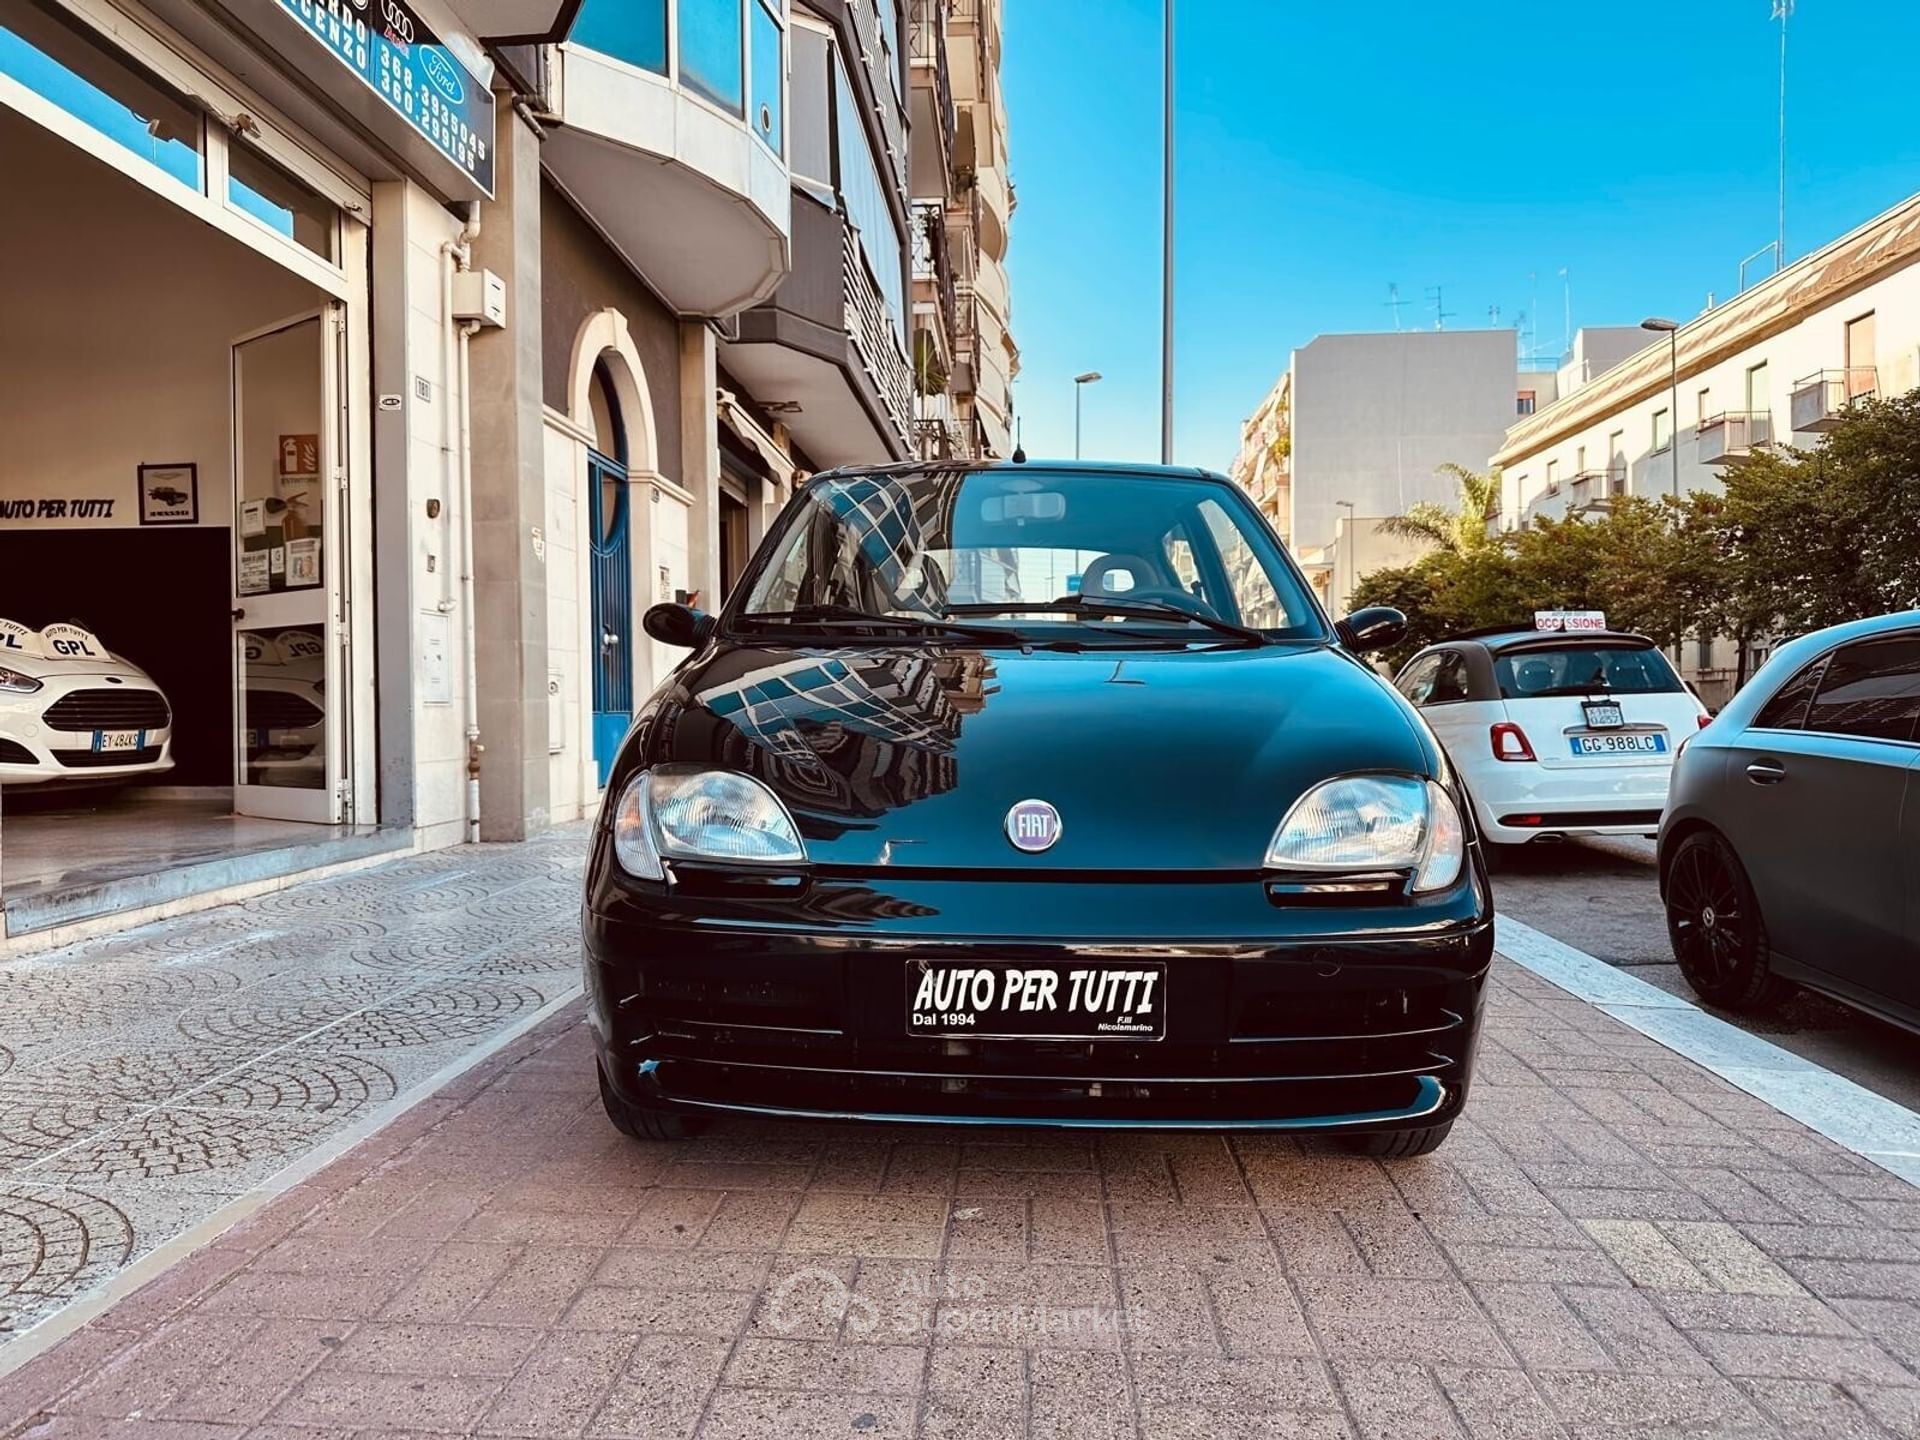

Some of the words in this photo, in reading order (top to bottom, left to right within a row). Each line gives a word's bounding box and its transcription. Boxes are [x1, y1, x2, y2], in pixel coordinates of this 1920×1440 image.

[284, 0, 366, 70] CENZO
[427, 54, 455, 96] Ford
[36, 499, 67, 518] PER
[69, 499, 115, 518] TUTTI
[53, 639, 96, 657] GPL
[1018, 813, 1051, 838] FIAT
[912, 968, 996, 1012] AUTO
[1000, 968, 1059, 1012] PER
[1067, 969, 1159, 1014] TUTTI
[912, 1012, 937, 1026] Dal
[940, 1013, 976, 1026] 1994
[1097, 1023, 1154, 1032] Nicolamarino
